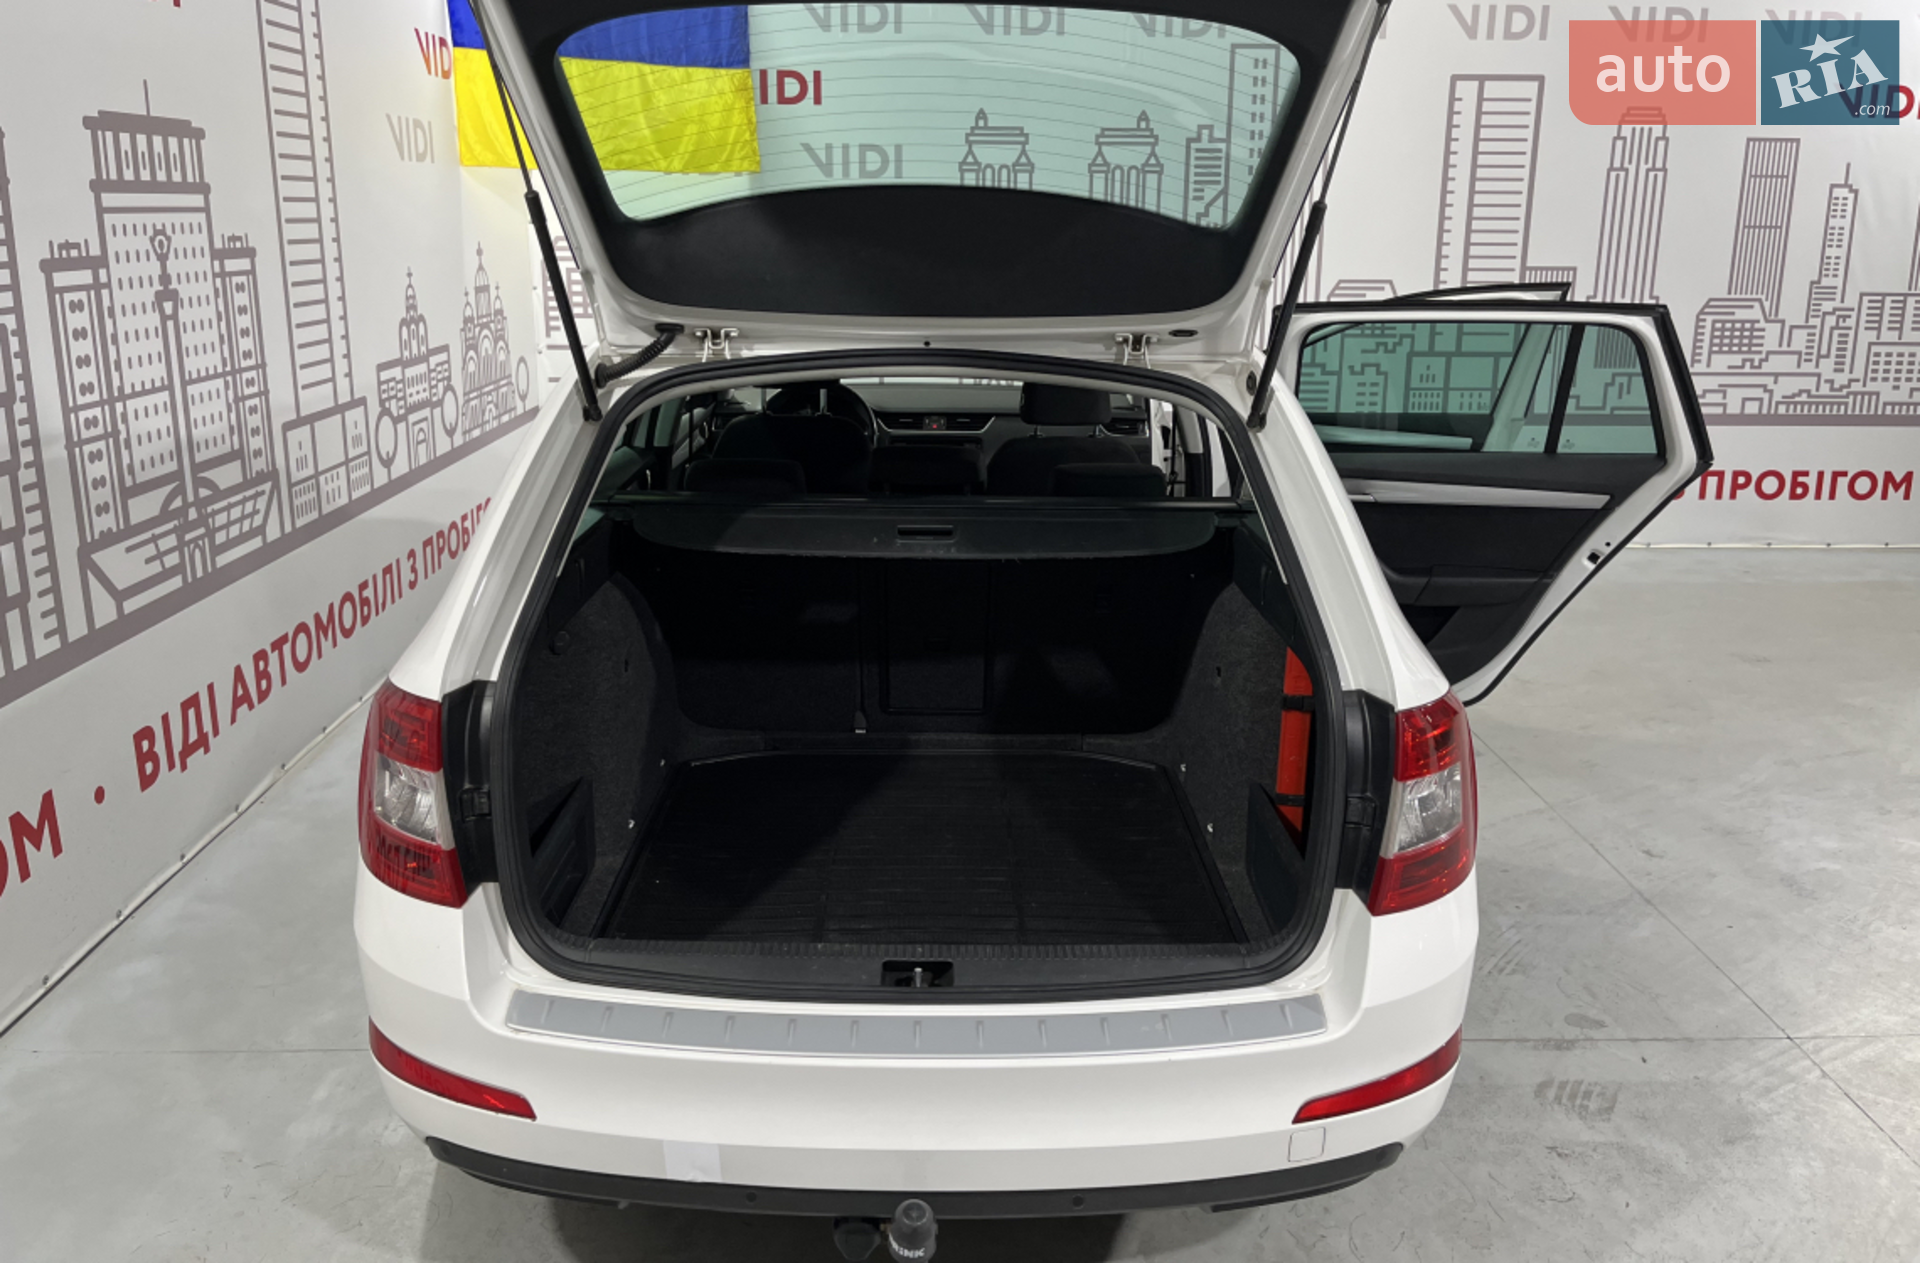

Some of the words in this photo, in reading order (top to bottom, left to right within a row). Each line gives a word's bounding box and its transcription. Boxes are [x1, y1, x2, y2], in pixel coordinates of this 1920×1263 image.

[803, 3, 902, 34] VIDI
[964, 4, 1065, 36] VIDI
[1447, 4, 1550, 41] VIDI
[1608, 5, 1709, 43] VIDI
[385, 113, 435, 164] VIDI
[800, 143, 903, 179] VIDI
[1698, 469, 1914, 501] ПРОБІГОМ
[132, 682, 220, 793] ВІДІ
[230, 557, 403, 725] АВТОМОБІЛІ
